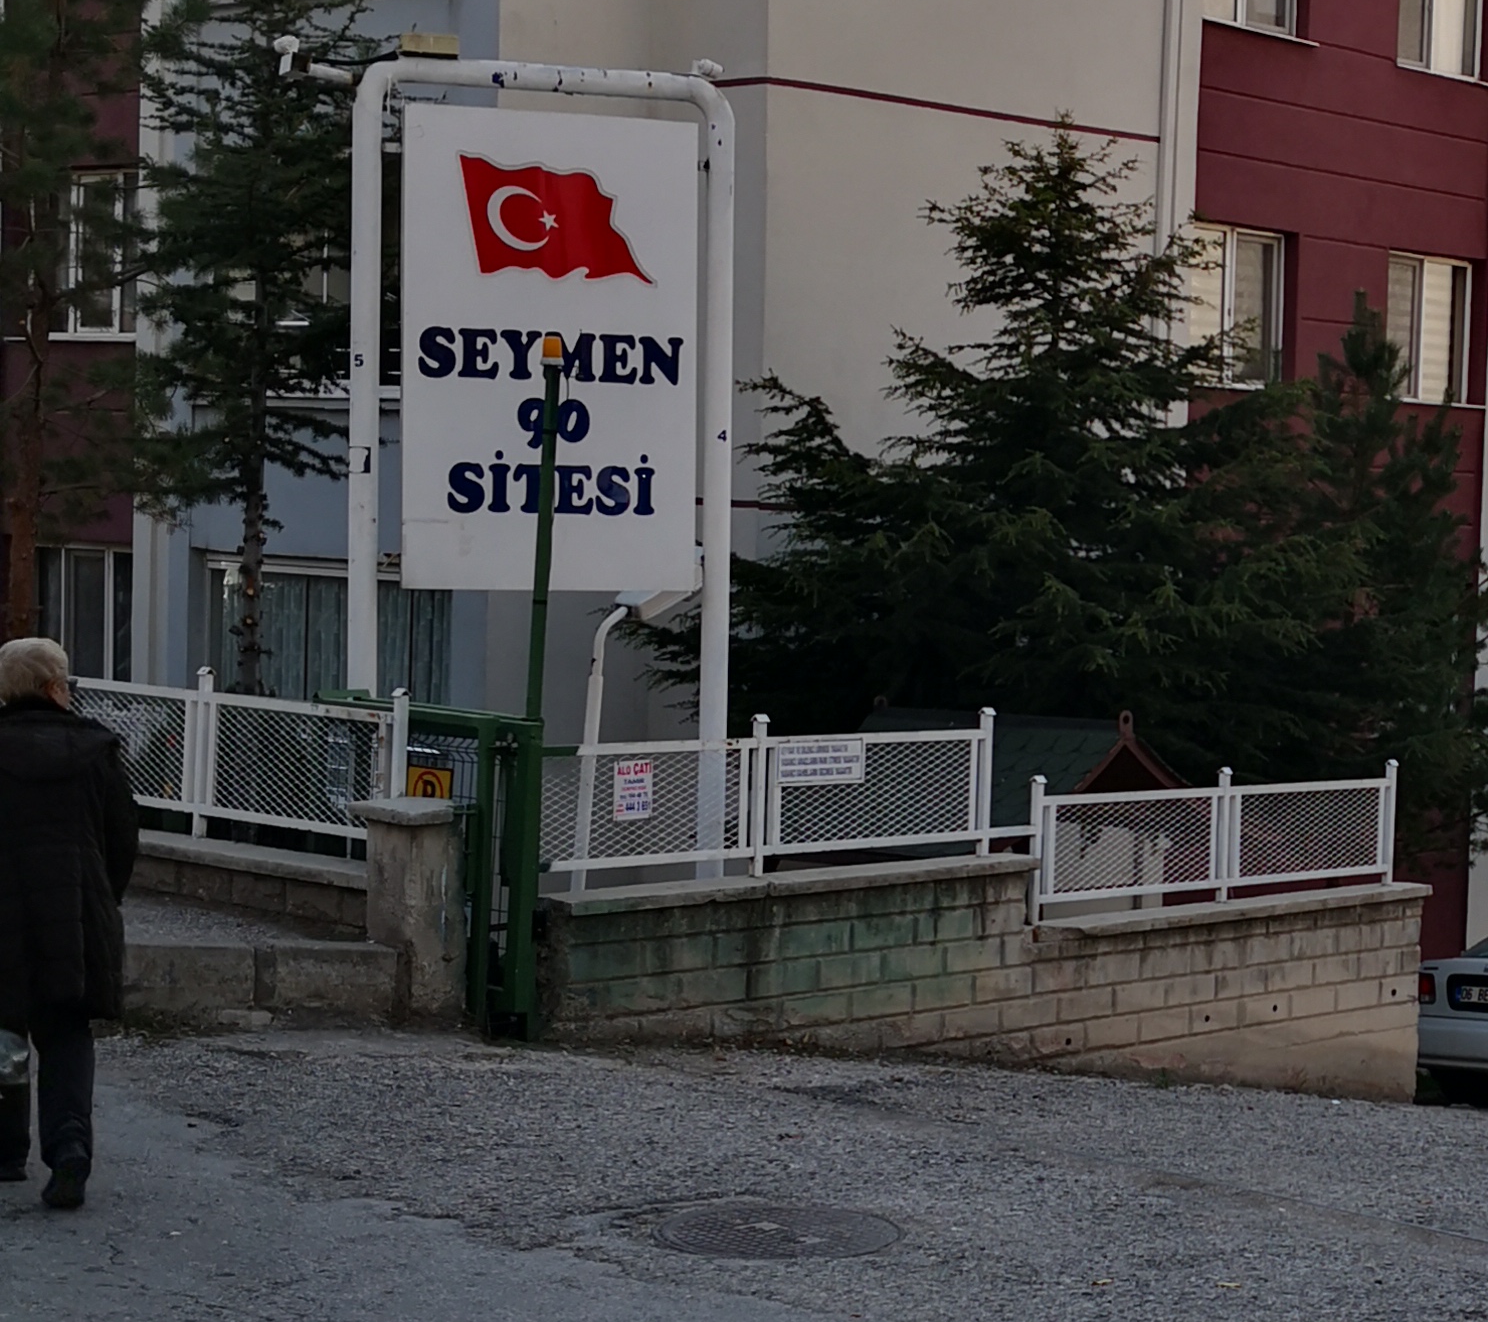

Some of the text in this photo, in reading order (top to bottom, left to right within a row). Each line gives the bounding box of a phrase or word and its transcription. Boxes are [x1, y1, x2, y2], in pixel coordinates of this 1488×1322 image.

[354, 353, 364, 367] 5
[418, 326, 684, 386] SEYMEN
[517, 397, 590, 449] 90
[717, 429, 727, 442] 4
[447, 449, 655, 515] SİTESİ
[1461, 987, 1474, 1001] 06
